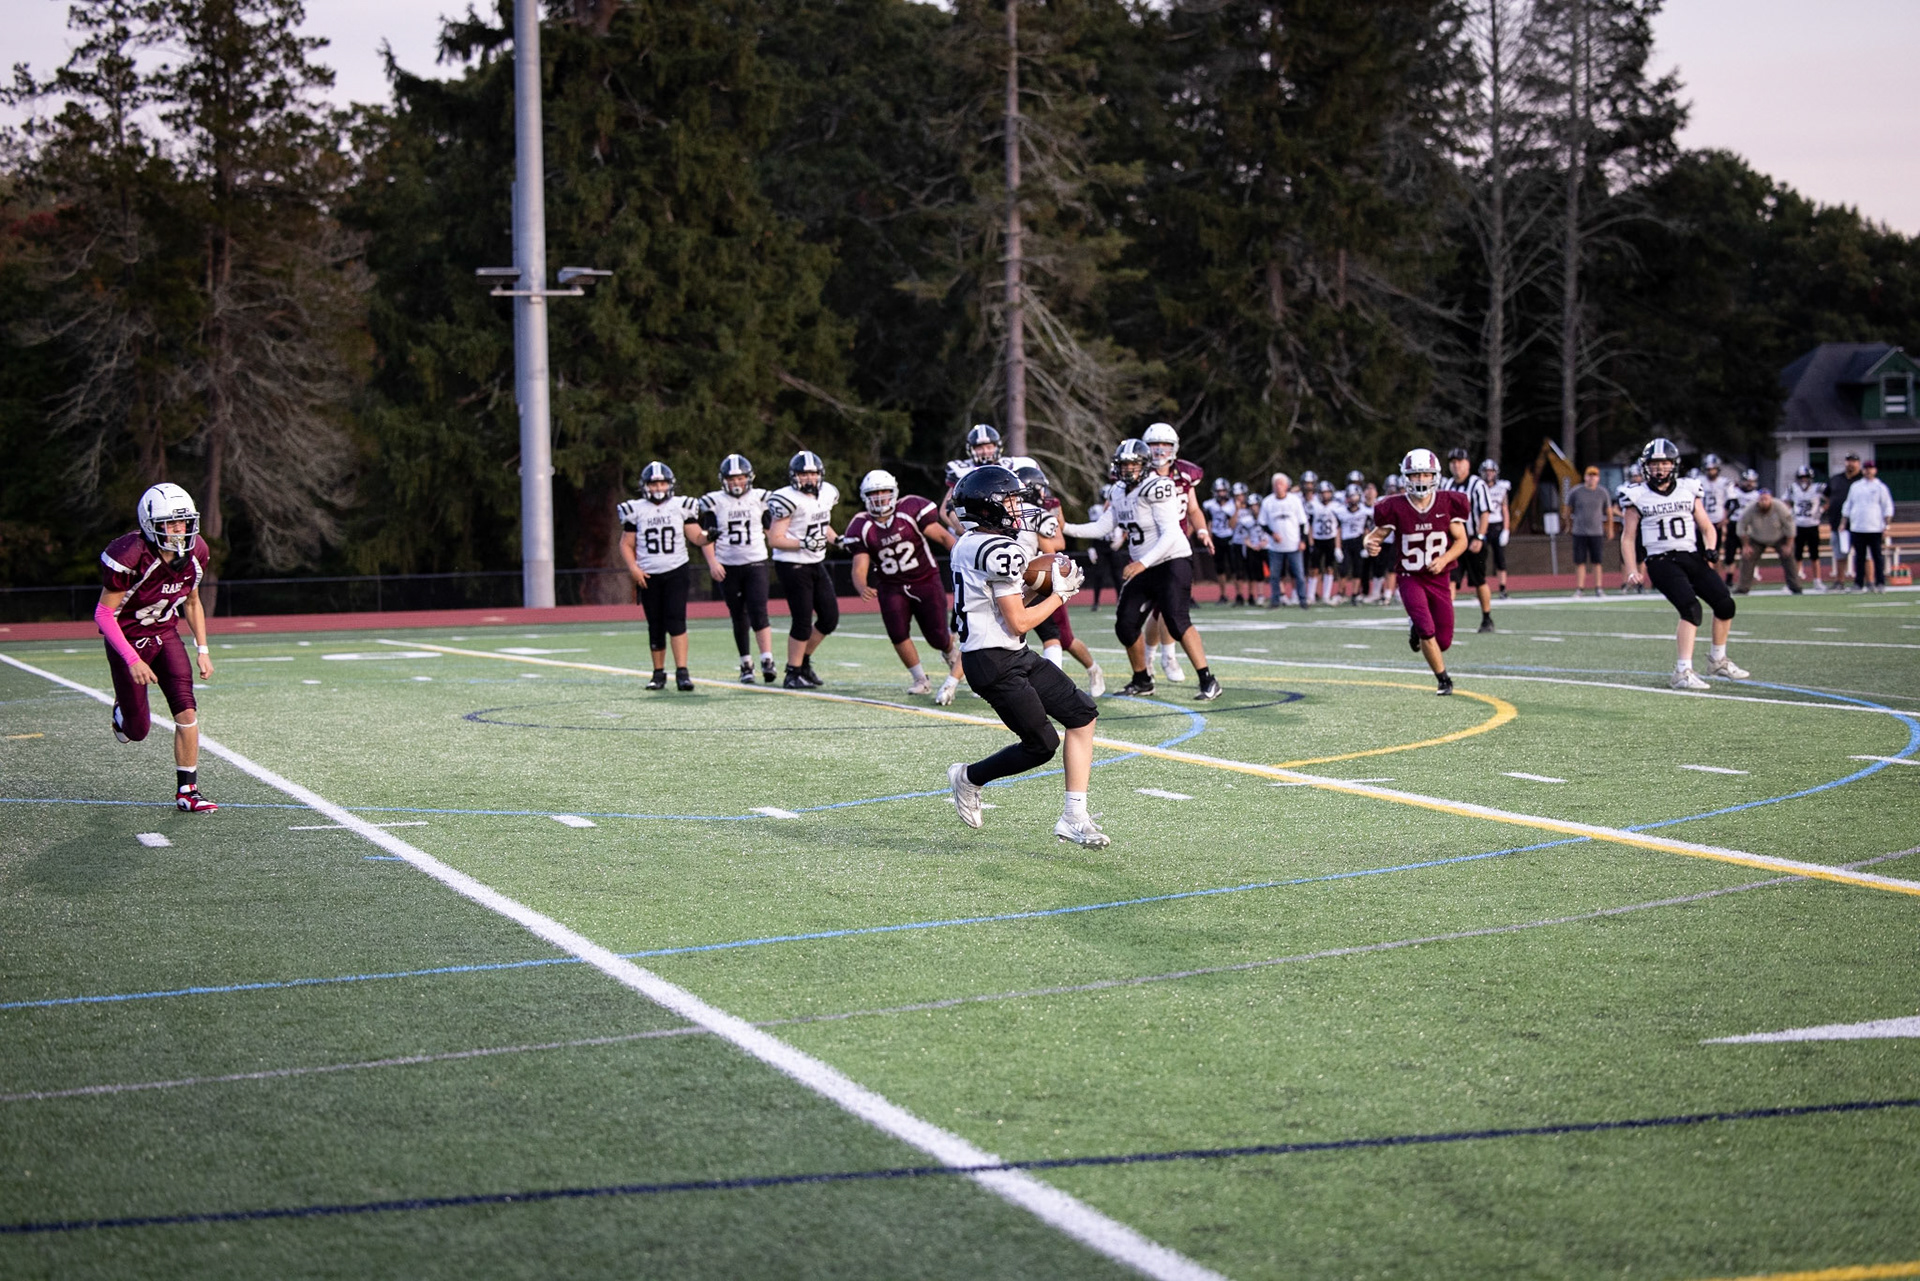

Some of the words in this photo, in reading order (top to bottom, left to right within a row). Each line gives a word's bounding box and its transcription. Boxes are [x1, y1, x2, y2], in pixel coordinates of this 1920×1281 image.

[644, 526, 676, 555] 60
[728, 520, 751, 545] 51
[1656, 517, 1686, 541] 10
[878, 541, 919, 575] 62
[996, 553, 1025, 576] 33
[1401, 531, 1448, 571] 58
